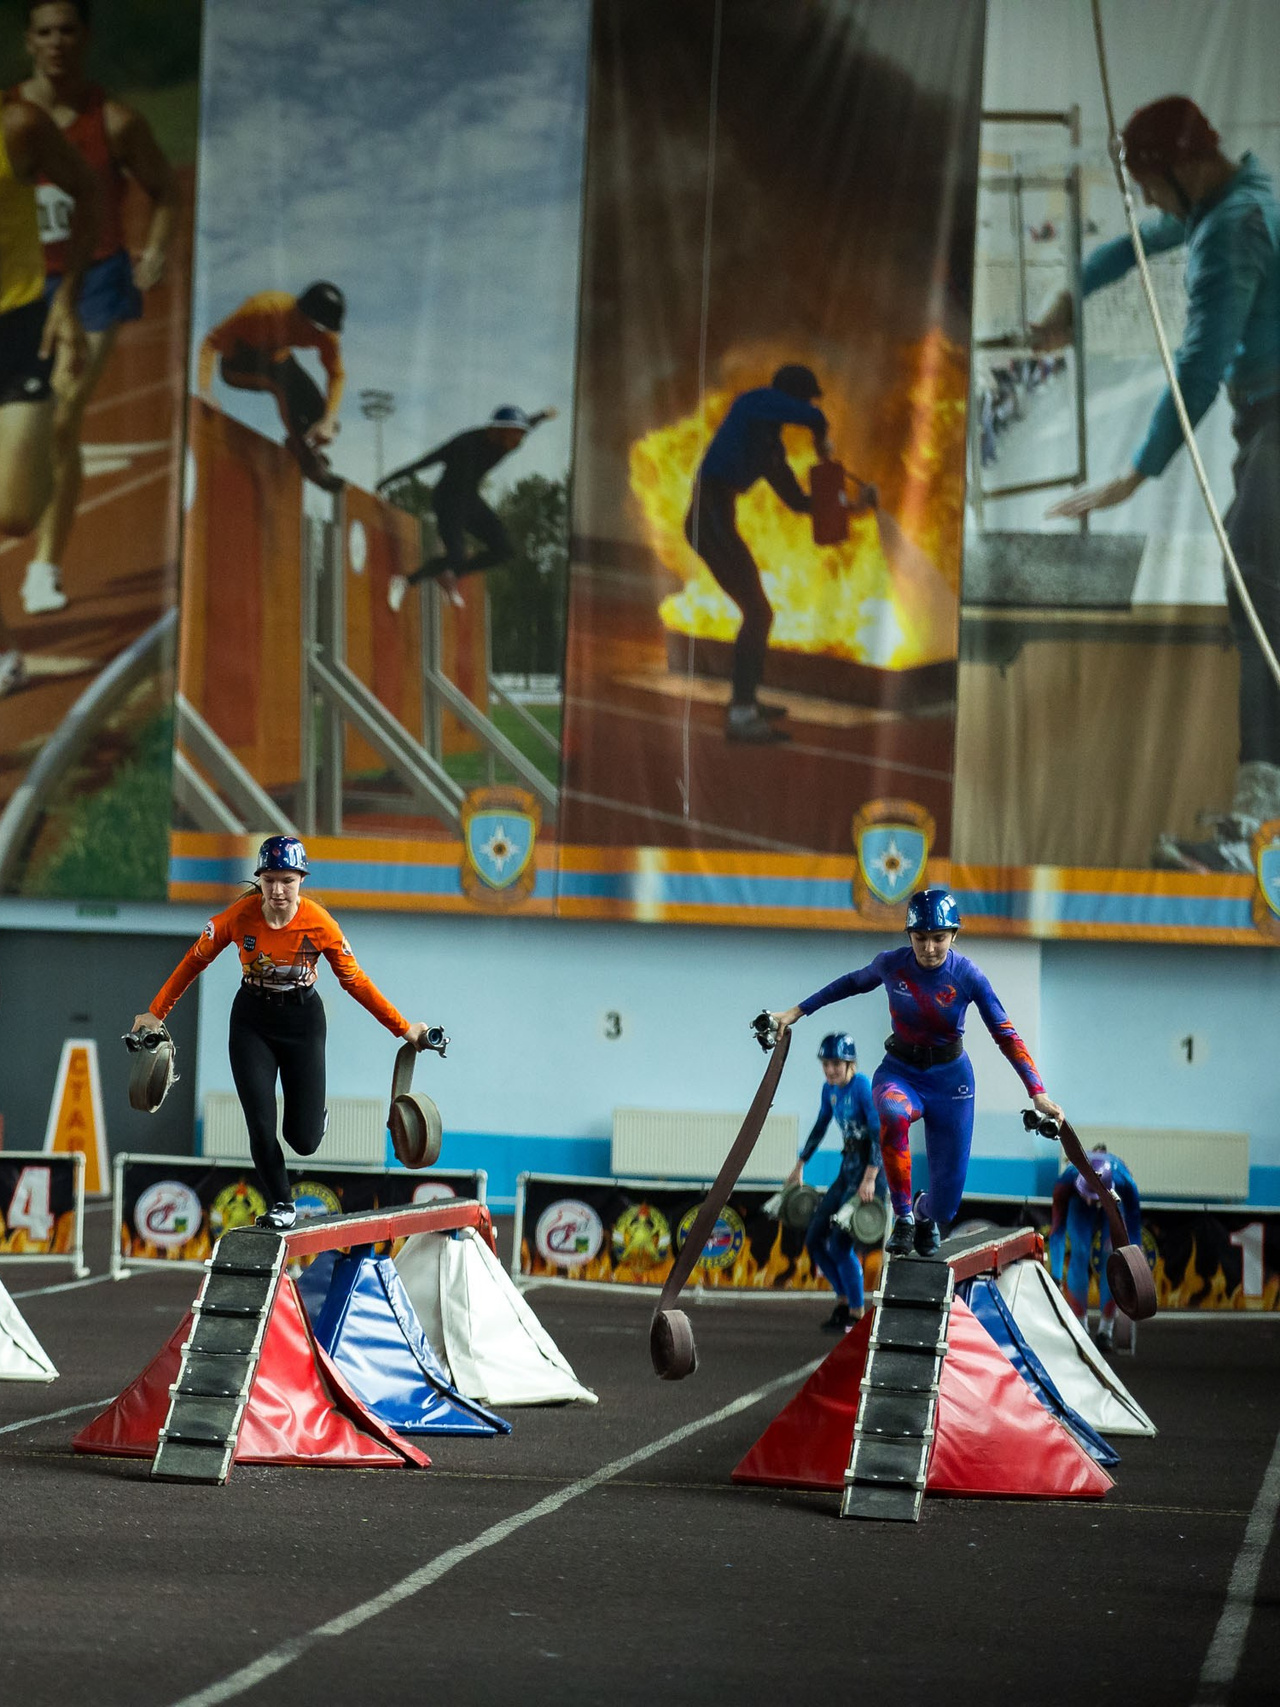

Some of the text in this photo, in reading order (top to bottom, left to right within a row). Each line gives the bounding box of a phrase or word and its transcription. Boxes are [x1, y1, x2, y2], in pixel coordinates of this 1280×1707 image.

[605, 1010, 623, 1040] 3
[1180, 1034, 1194, 1065] 1
[7, 1166, 55, 1242] 4
[1229, 1222, 1265, 1297] 1
